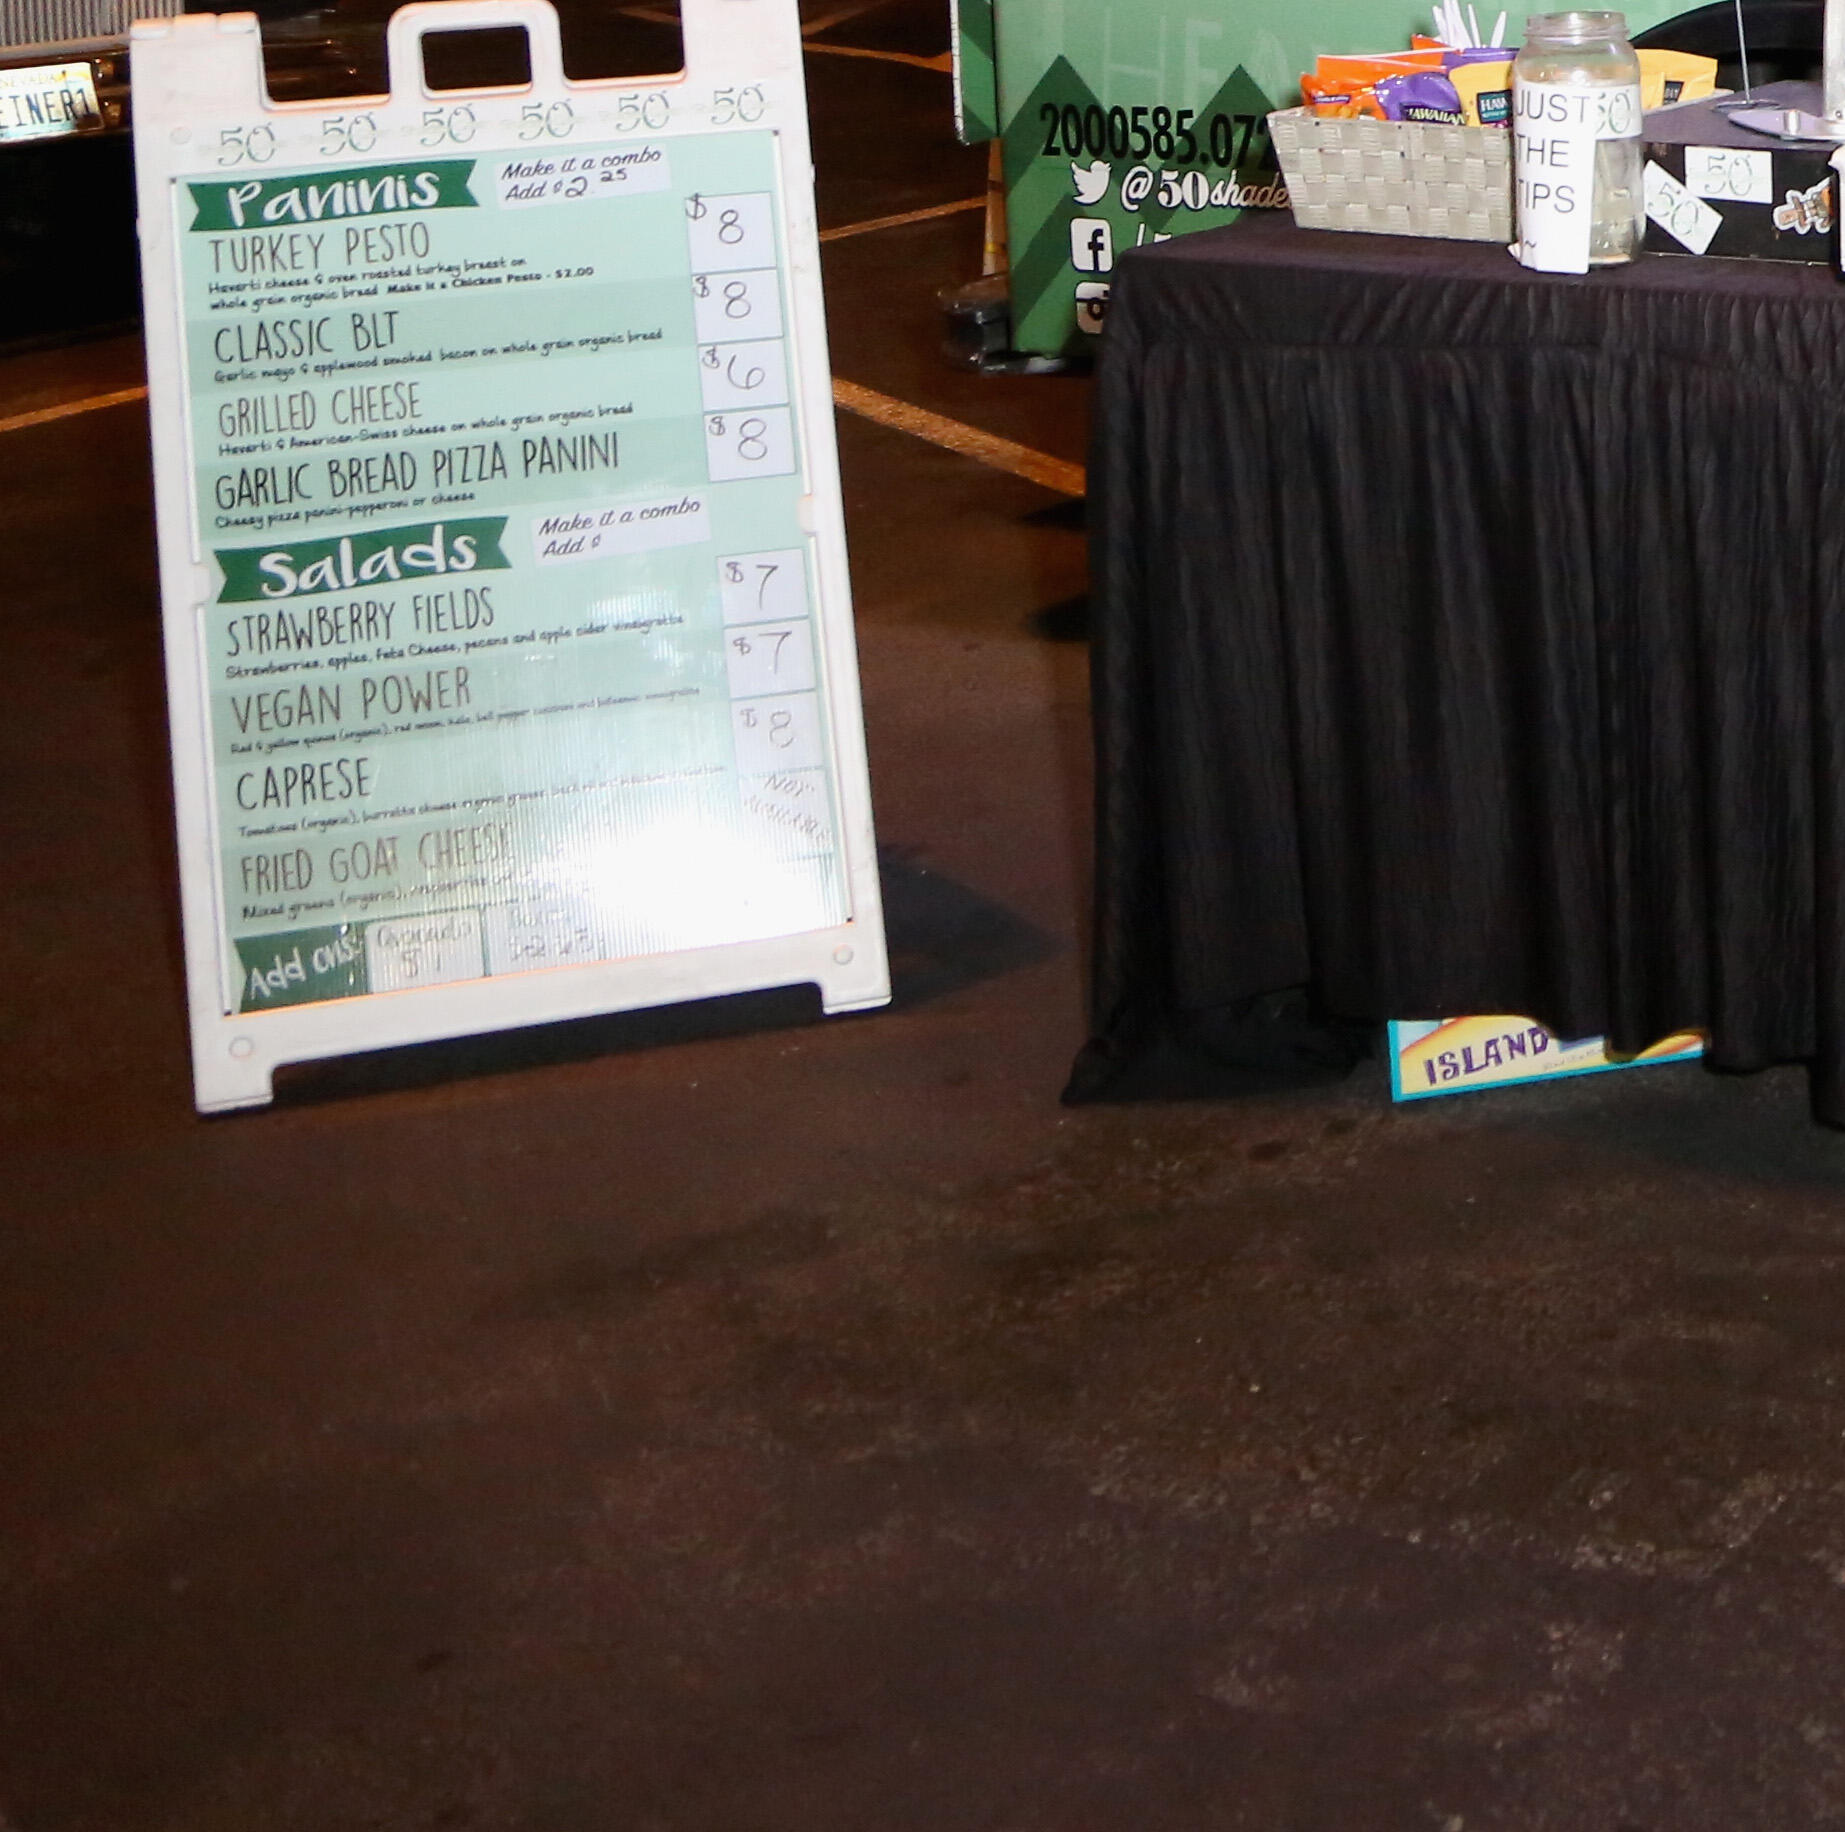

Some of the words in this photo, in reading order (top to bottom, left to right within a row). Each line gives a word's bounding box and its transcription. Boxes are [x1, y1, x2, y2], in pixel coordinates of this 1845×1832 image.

[218, 121, 277, 166] 50
[320, 111, 378, 156] 50
[420, 103, 477, 147] 50
[518, 98, 575, 141] 50
[615, 90, 671, 131] 50
[711, 83, 765, 124] 50
[1516, 90, 1589, 124] JUST
[501, 161, 554, 180] Make
[560, 156, 577, 173] it
[581, 158, 595, 170] a
[601, 145, 662, 168] combo
[1516, 140, 1569, 169] THE
[1703, 150, 1756, 196] 50
[227, 172, 440, 227] Paninis
[505, 183, 546, 201] Add
[1517, 185, 1576, 215] TIPS
[1646, 180, 1701, 238] 50
[209, 232, 325, 273] TURKEY
[346, 221, 430, 266] PESTO
[215, 316, 334, 364] CLASSIC
[352, 310, 400, 352] BLT
[219, 390, 316, 437] GRILLED
[332, 382, 423, 425] CHEESE
[215, 464, 313, 510] GARLIC
[328, 451, 417, 498] BREAD
[433, 440, 509, 489] PIZZA
[522, 430, 620, 478] PANINI
[539, 515, 593, 536] Make
[600, 509, 616, 526] it
[619, 509, 634, 524] a
[639, 496, 701, 520] combo
[259, 523, 477, 598] Salads
[542, 535, 584, 558] Add
[226, 601, 396, 657] STRAWBERRY
[412, 586, 495, 634] FIELDS
[230, 683, 342, 734] VEGAN
[361, 665, 472, 719] POWER
[236, 757, 372, 810] CAPRESE
[240, 847, 313, 894] FRIED
[329, 835, 400, 883] GOAT
[249, 947, 307, 1000] Add
[1422, 1024, 1551, 1086] ISLAND
